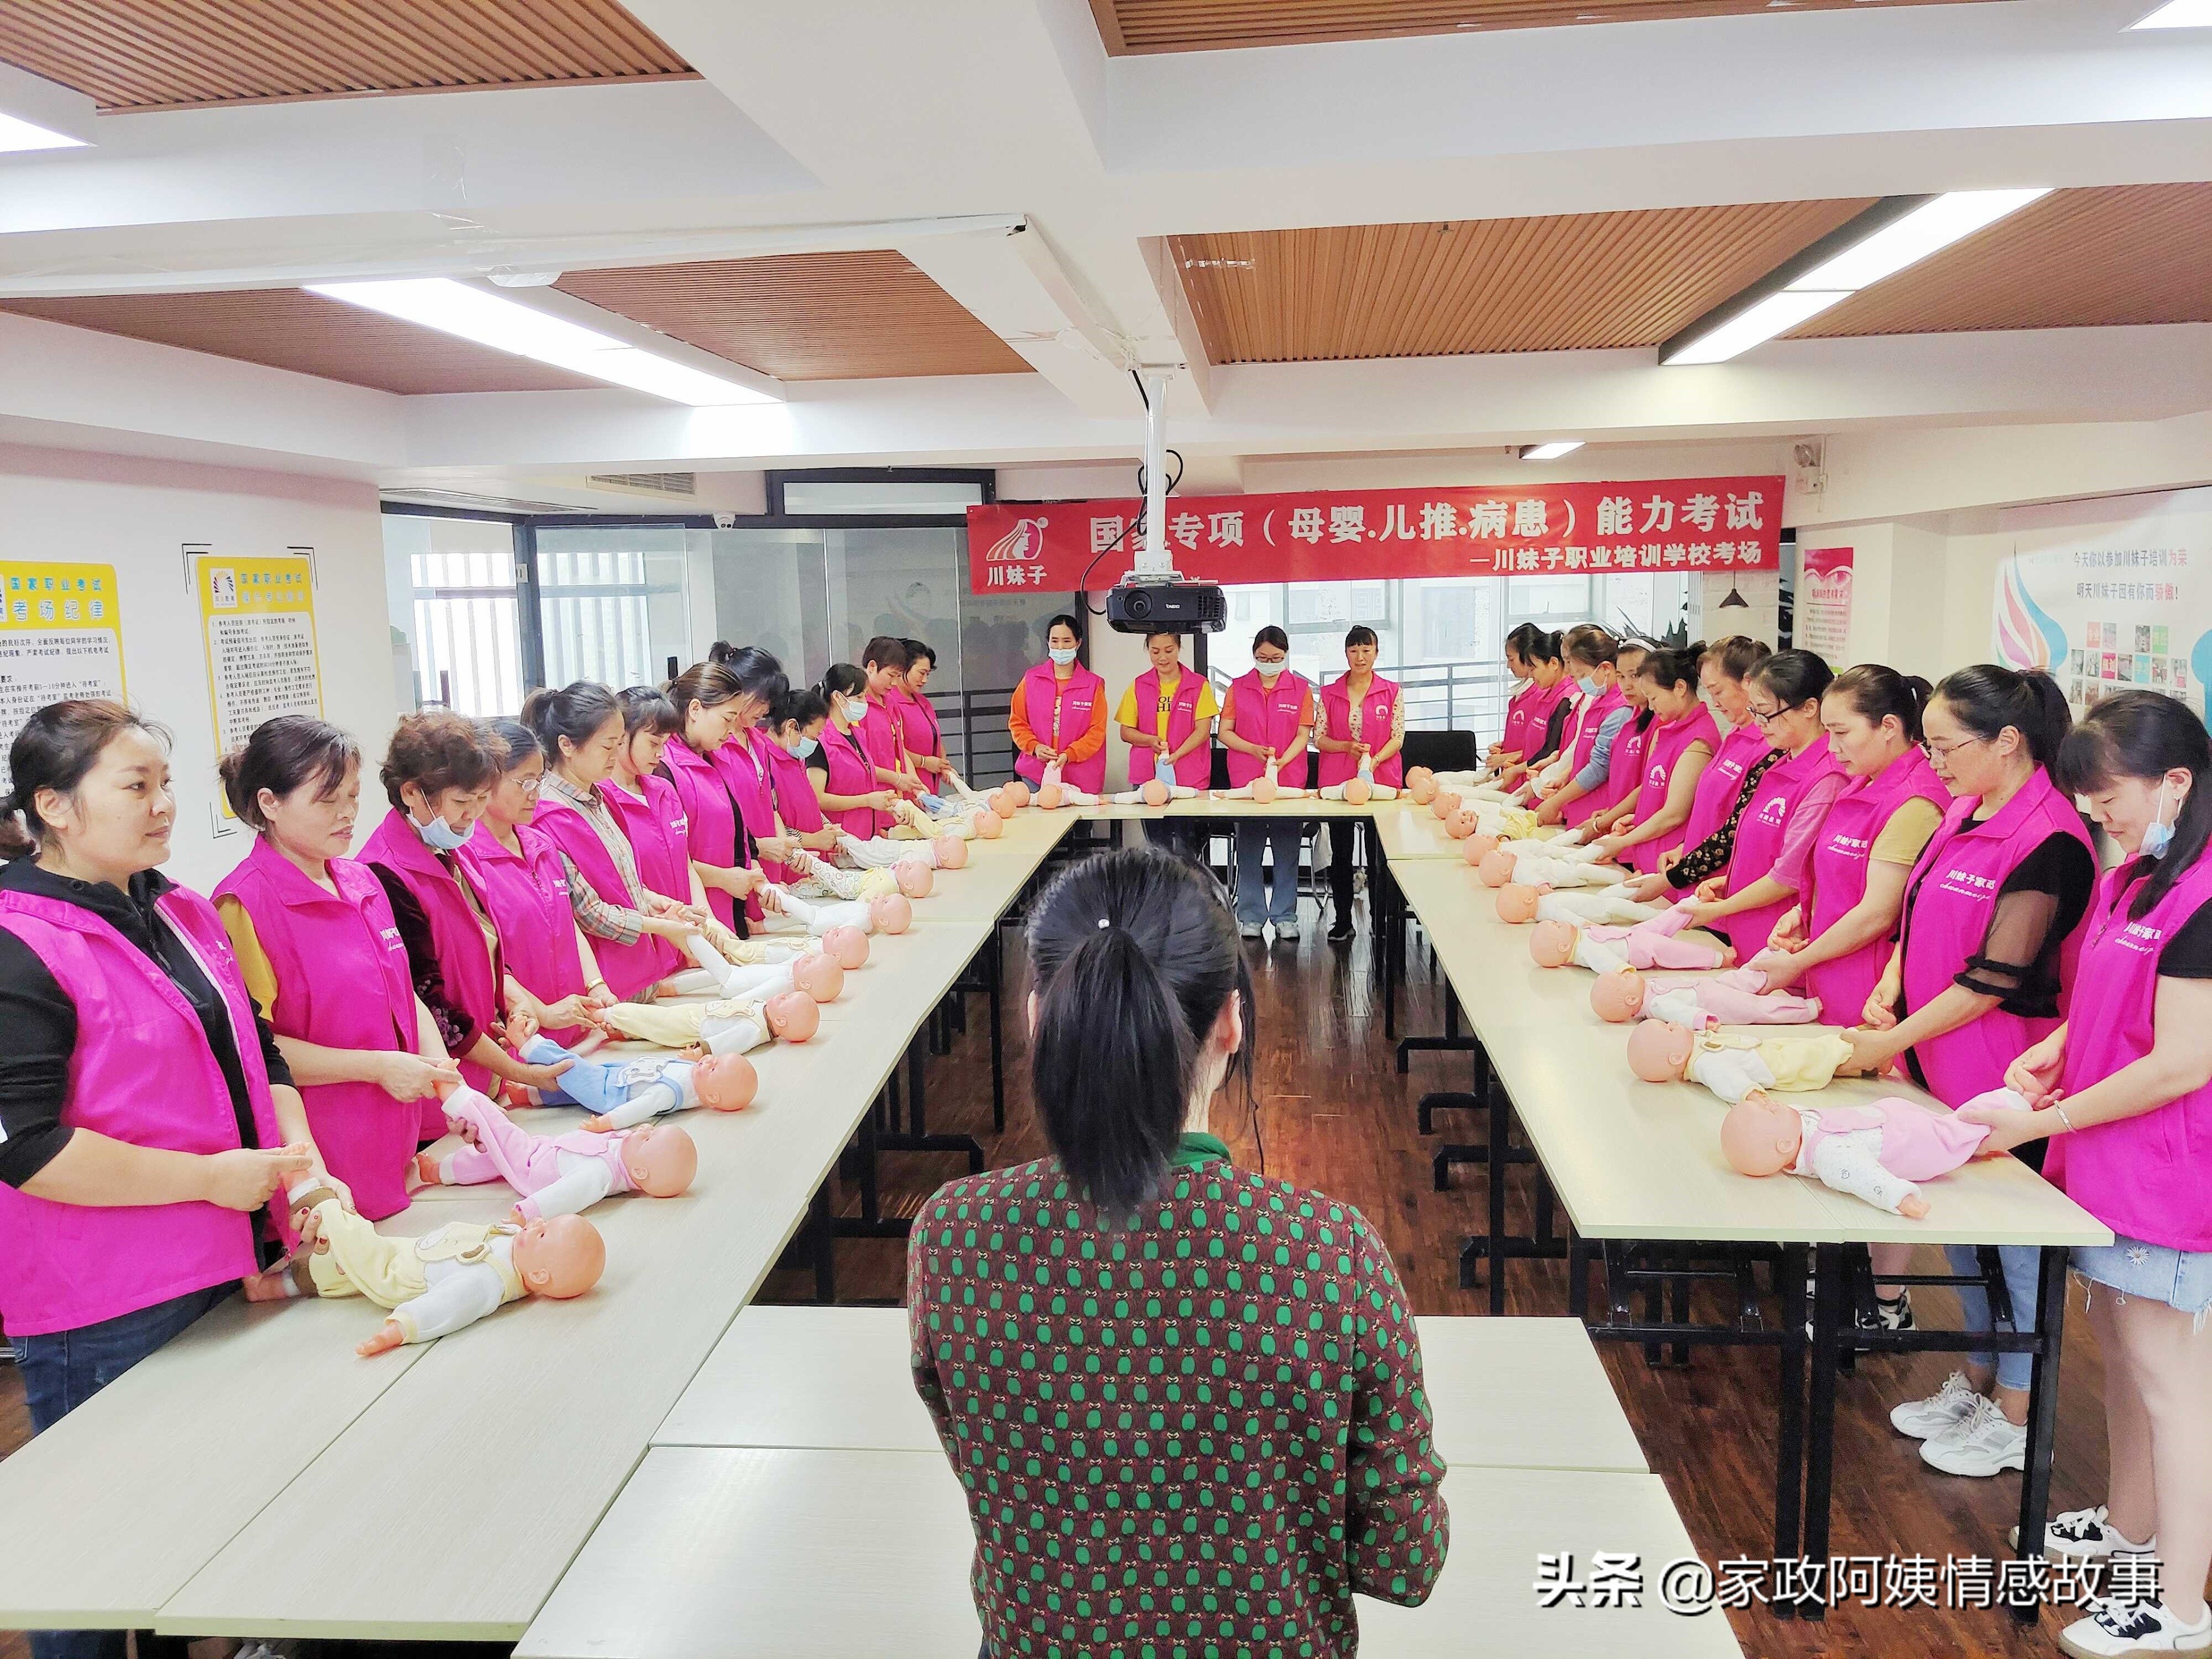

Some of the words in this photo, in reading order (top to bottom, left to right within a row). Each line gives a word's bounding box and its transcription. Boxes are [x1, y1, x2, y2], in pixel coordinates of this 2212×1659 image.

[2074, 549, 2188, 568] 今天你以参加川妹子培训为荣
[11, 577, 101, 591] 国家职业考试
[987, 565, 1047, 586] 川妹子
[13, 601, 103, 621] 考场纪律
